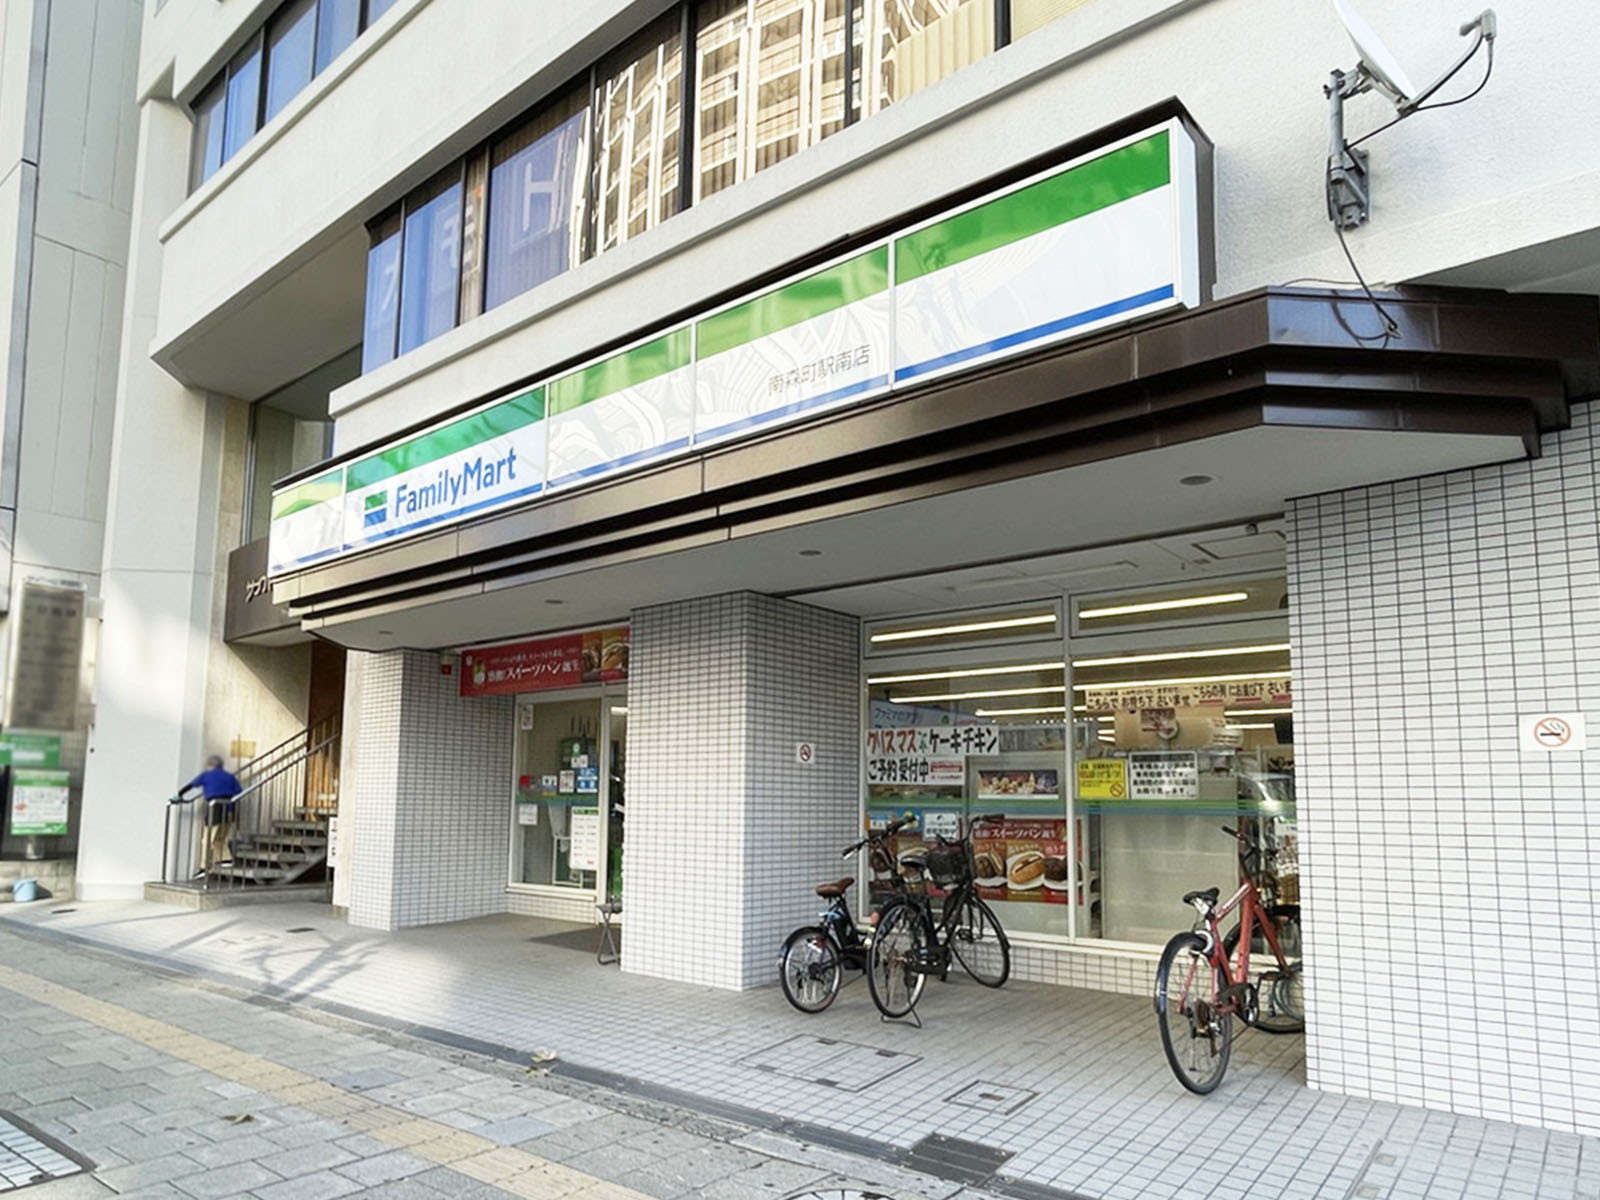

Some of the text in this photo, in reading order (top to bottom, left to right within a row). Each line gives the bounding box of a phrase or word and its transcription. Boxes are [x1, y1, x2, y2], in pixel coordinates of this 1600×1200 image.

[767, 344, 871, 396] 南森町駅南店
[394, 446, 517, 518] FamilyMart
[868, 757, 929, 783] ご予約受付中
